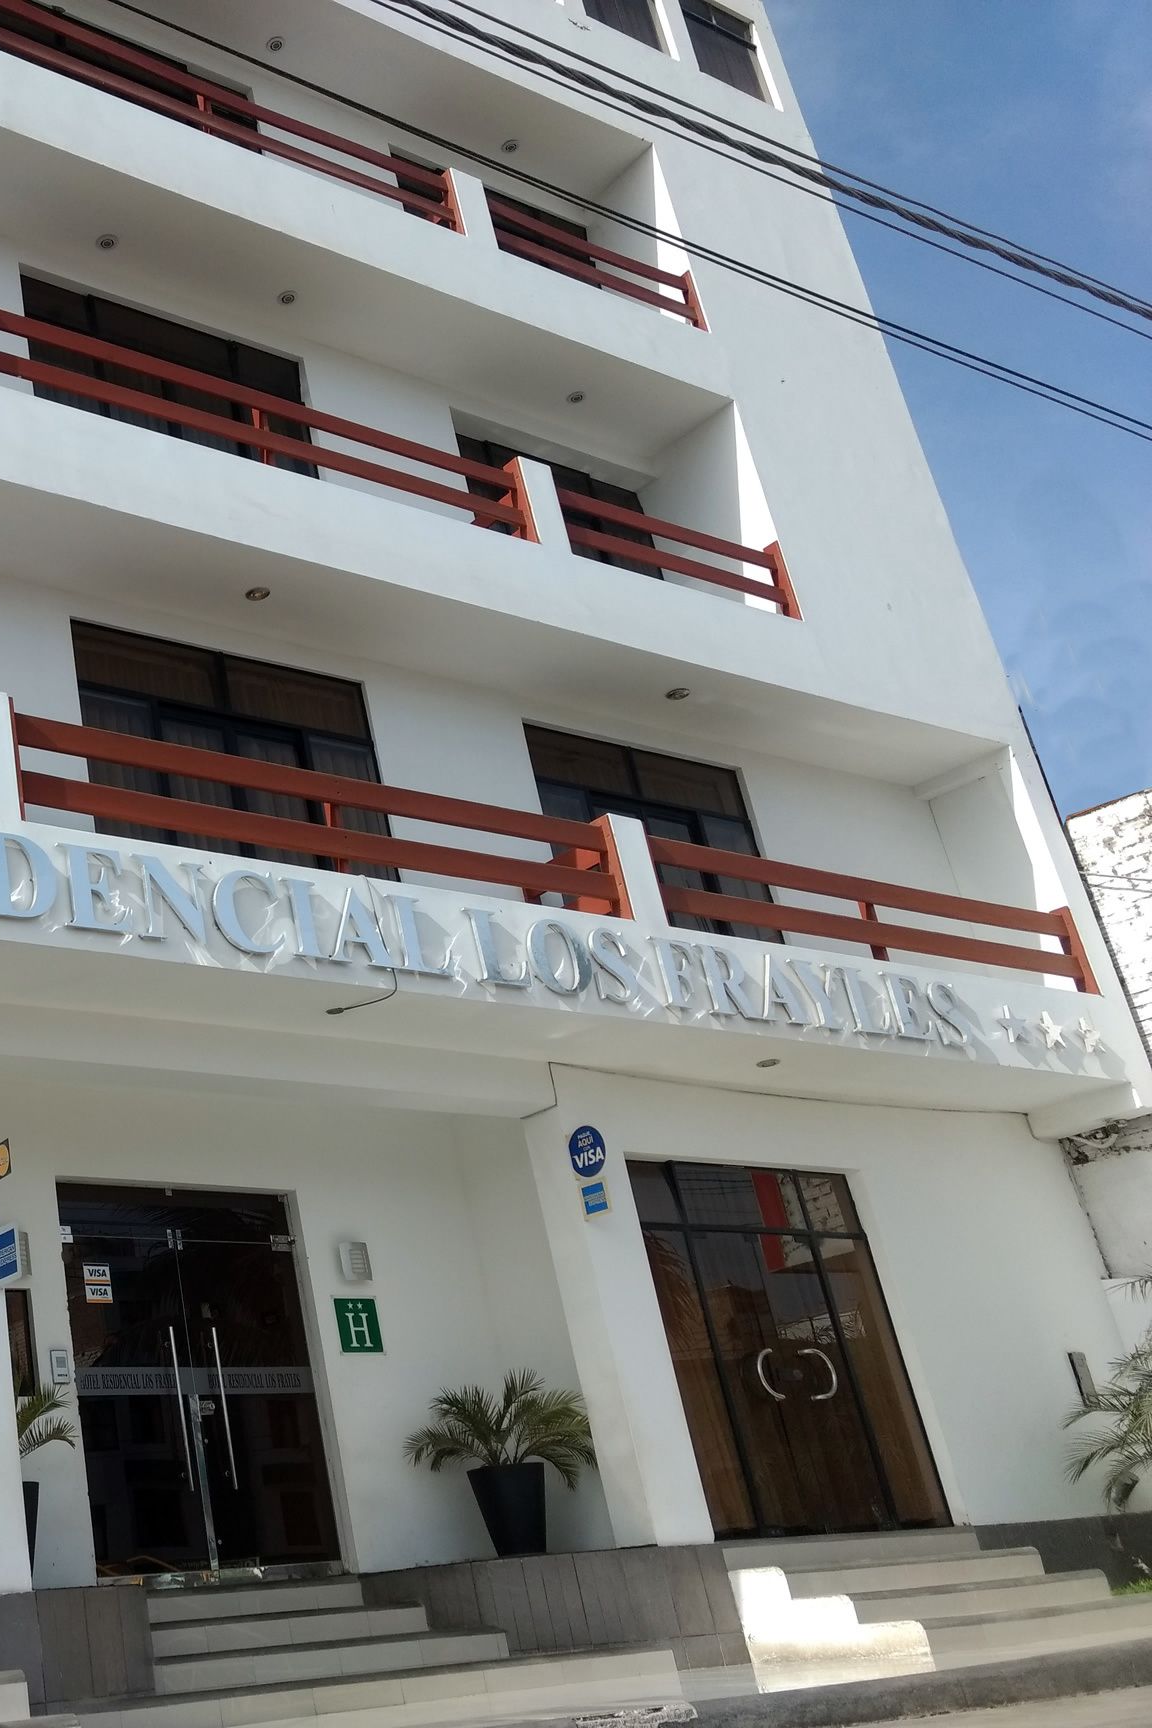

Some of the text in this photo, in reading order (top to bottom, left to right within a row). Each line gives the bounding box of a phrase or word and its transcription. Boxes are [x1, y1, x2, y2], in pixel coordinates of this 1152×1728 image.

[461, 906, 631, 1001] LOS
[646, 936, 969, 1047] FRAYLES
[573, 1147, 604, 1168] VISA
[87, 1268, 107, 1278] VISA
[89, 1287, 109, 1297] VISA
[345, 1312, 374, 1347] H
[101, 1373, 140, 1389] RESIDENCIAL
[141, 1373, 154, 1389] LOS
